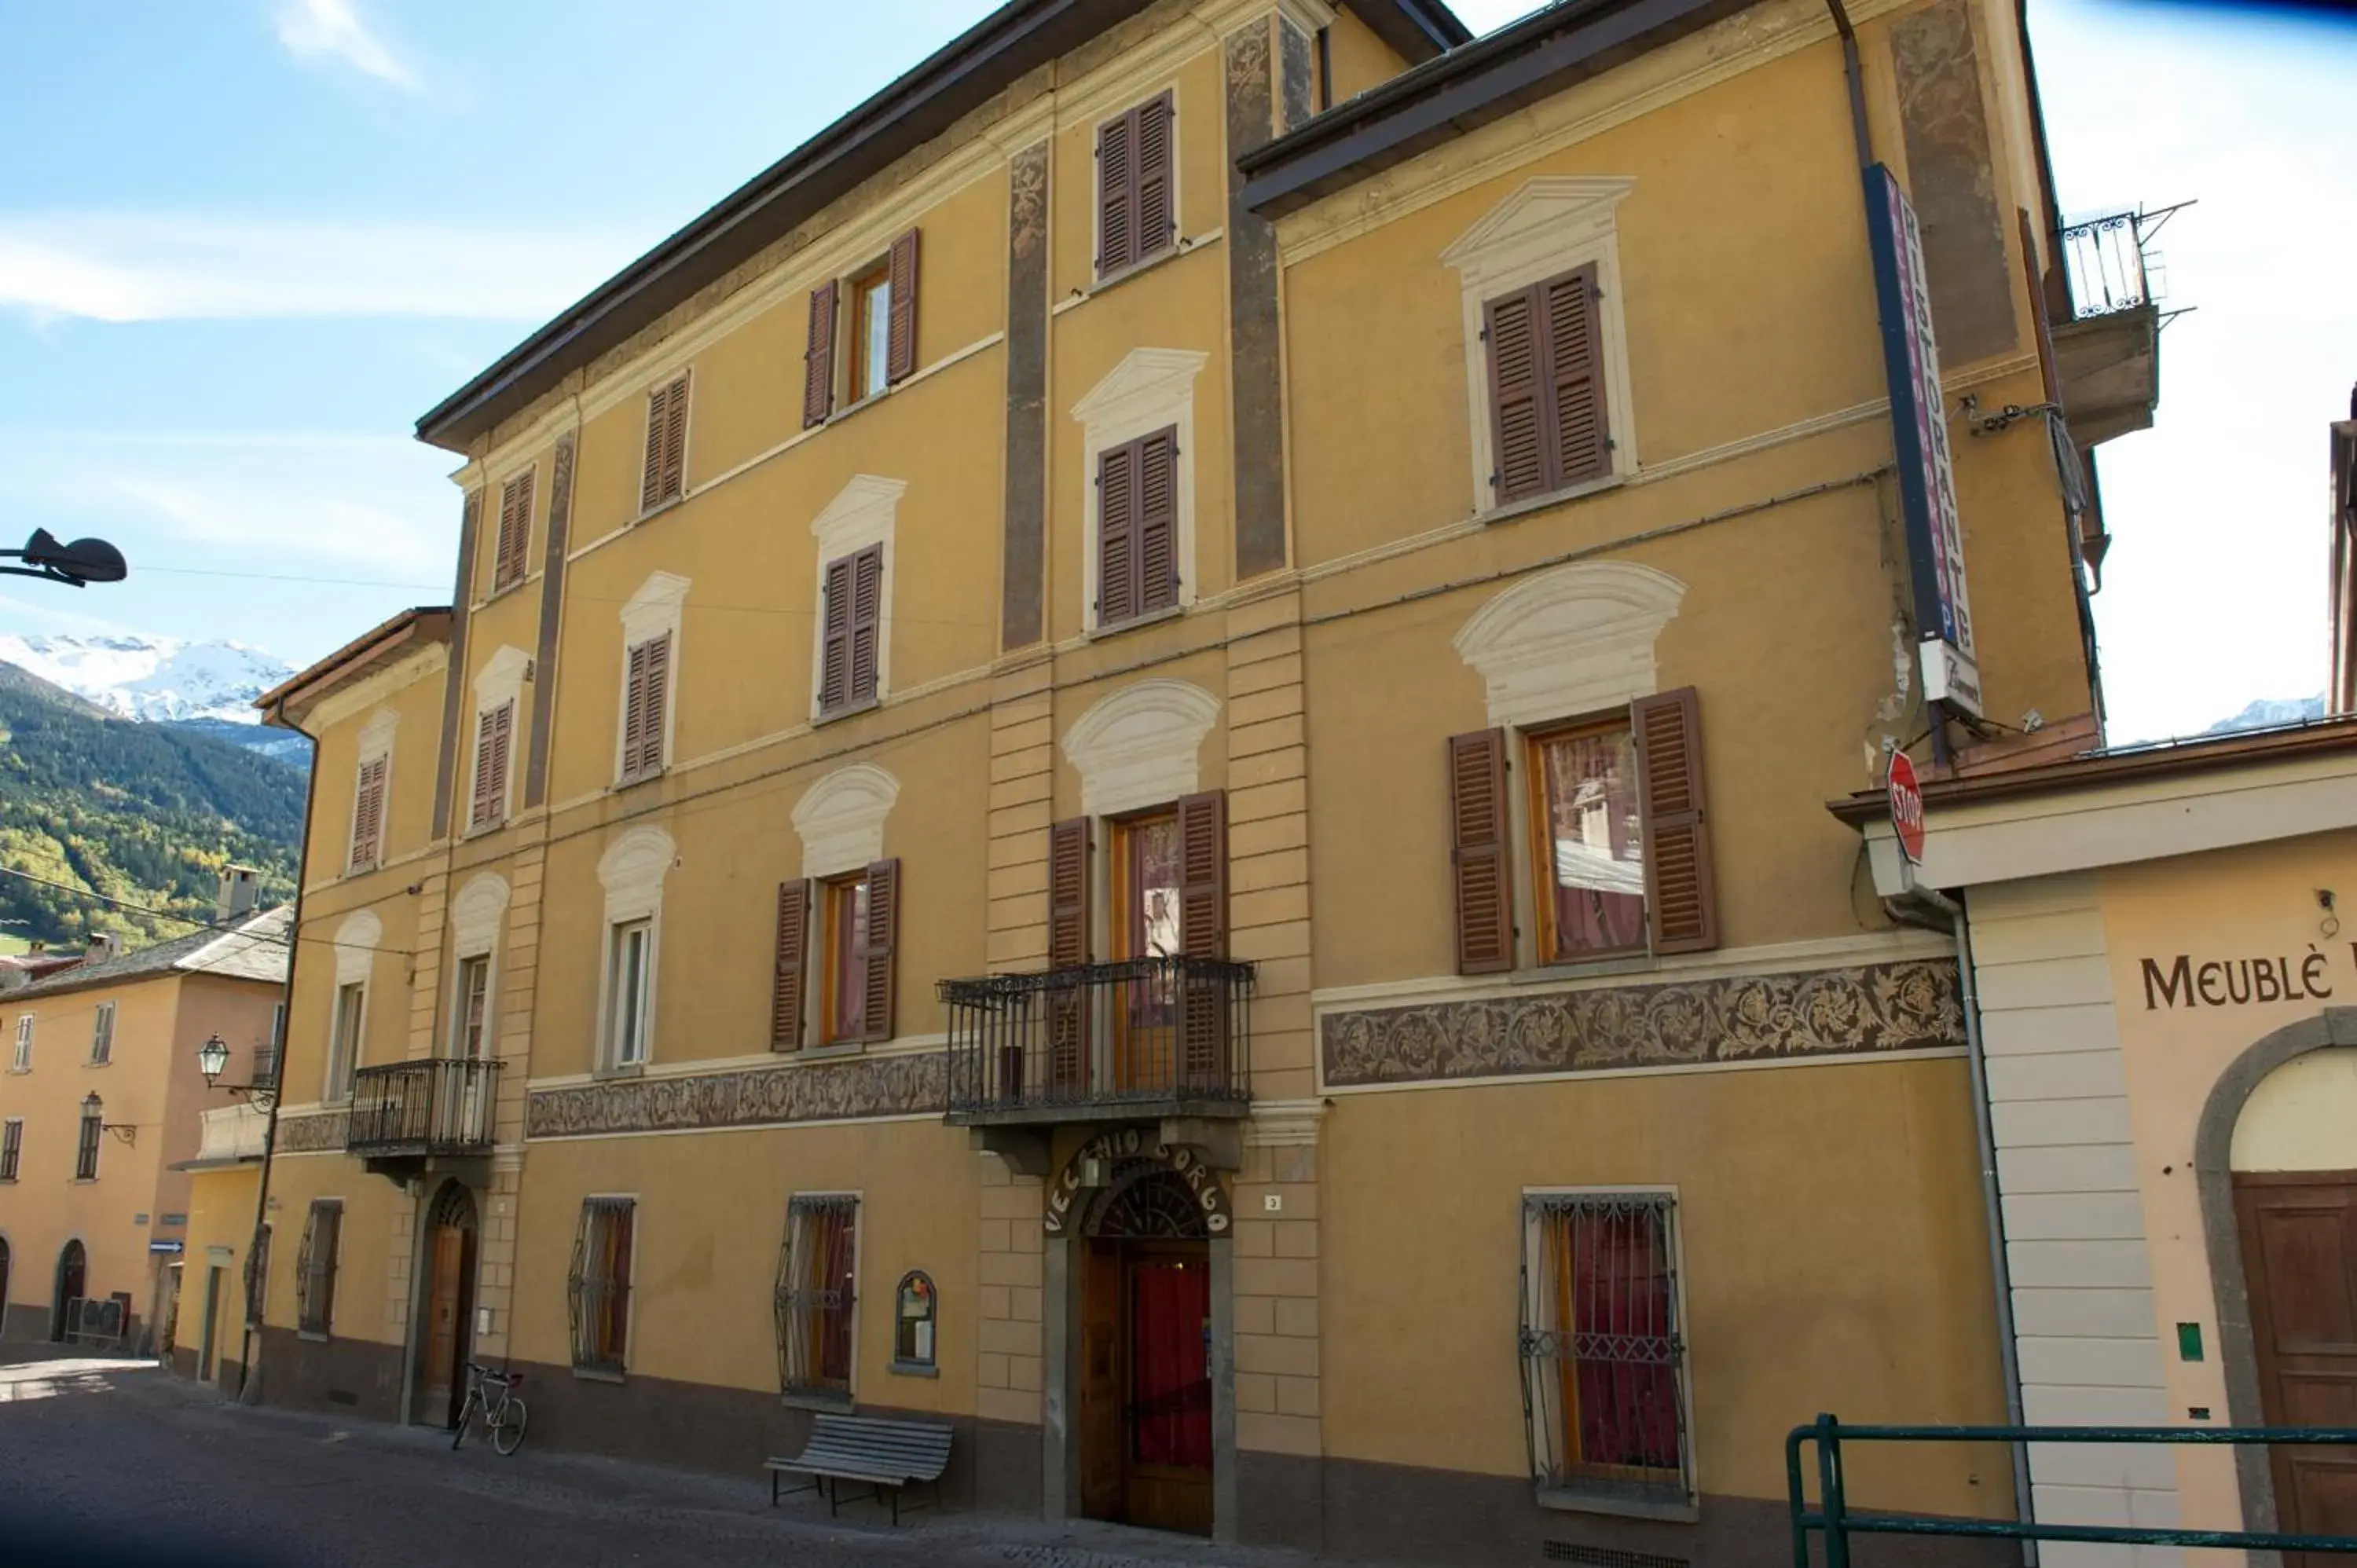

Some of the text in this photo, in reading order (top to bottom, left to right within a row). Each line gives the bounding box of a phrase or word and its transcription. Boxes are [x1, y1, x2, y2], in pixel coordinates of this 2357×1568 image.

[1902, 200, 1970, 649] RISTORANTE
[1892, 781, 1922, 831] STOP
[2139, 943, 2333, 1010] MEUBLÈ
